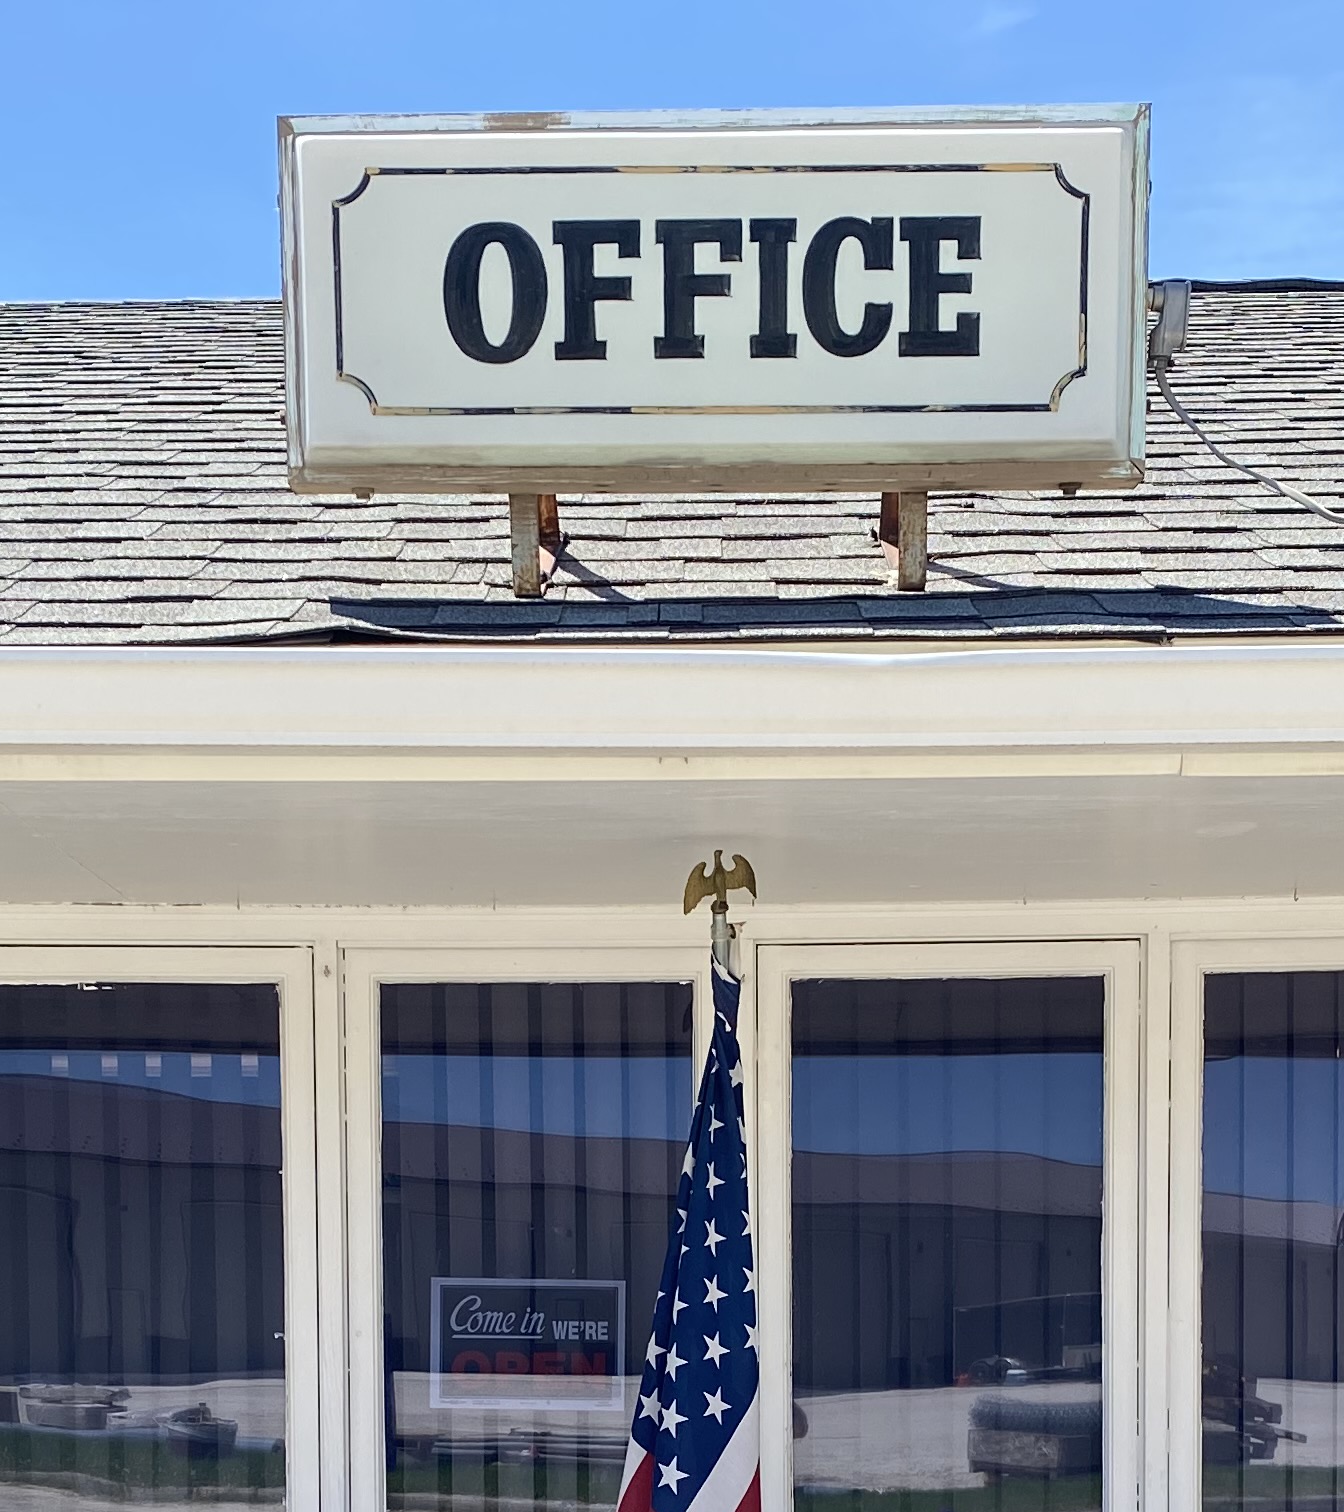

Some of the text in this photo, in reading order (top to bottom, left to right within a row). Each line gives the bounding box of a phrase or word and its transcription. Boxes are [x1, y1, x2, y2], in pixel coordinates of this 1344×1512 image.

[443, 216, 982, 364] OFFICE
[450, 1295, 608, 1340] Come in WE'RE
[451, 1351, 607, 1387] OPEN
